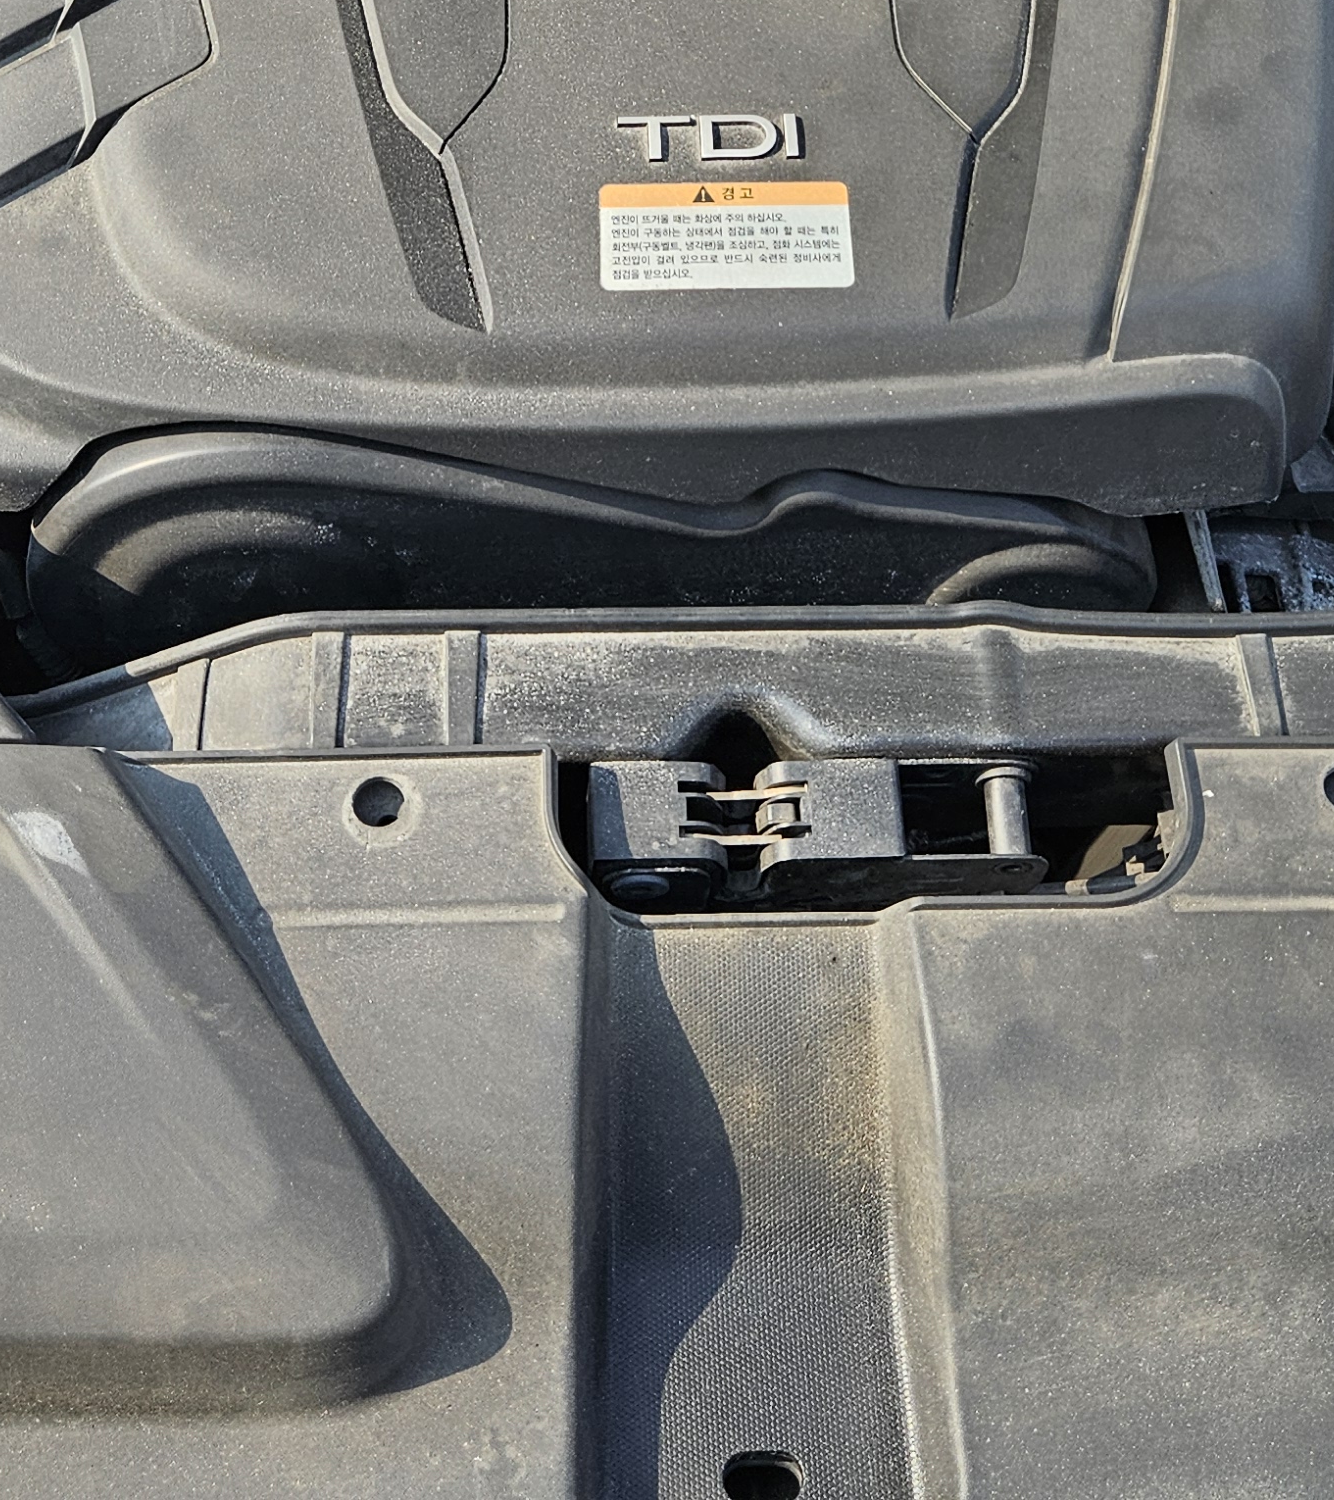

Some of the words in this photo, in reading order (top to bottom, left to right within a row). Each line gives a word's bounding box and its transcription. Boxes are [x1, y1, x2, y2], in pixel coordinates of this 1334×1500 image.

[617, 113, 801, 161] TDI
[611, 214, 639, 225] 엔진이
[642, 214, 669, 224] 뜨거울
[672, 214, 691, 224] 때는
[695, 214, 722, 224] 화상에
[725, 213, 744, 223] 주의
[747, 213, 787, 223] 하십시오.
[611, 228, 639, 238] 엔진이
[643, 228, 681, 238] 구동하는
[686, 227, 723, 238] 상태에서
[728, 226, 755, 237] 점검을
[760, 226, 778, 236] 해야
[784, 226, 792, 236] 할
[797, 226, 816, 236] 때는
[820, 225, 839, 235] 특히
[772, 239, 790, 250] 점화
[793, 239, 841, 250] 시스템에는
[612, 255, 650, 265] 고전압이
[656, 255, 675, 265] 걸려
[680, 254, 719, 264] 있으므로
[724, 253, 754, 264] 반드시
[759, 253, 787, 263] 숙련된
[793, 252, 842, 263] 정비사에게
[612, 269, 640, 280] 점검을
[643, 268, 693, 279] 받으십시오.
